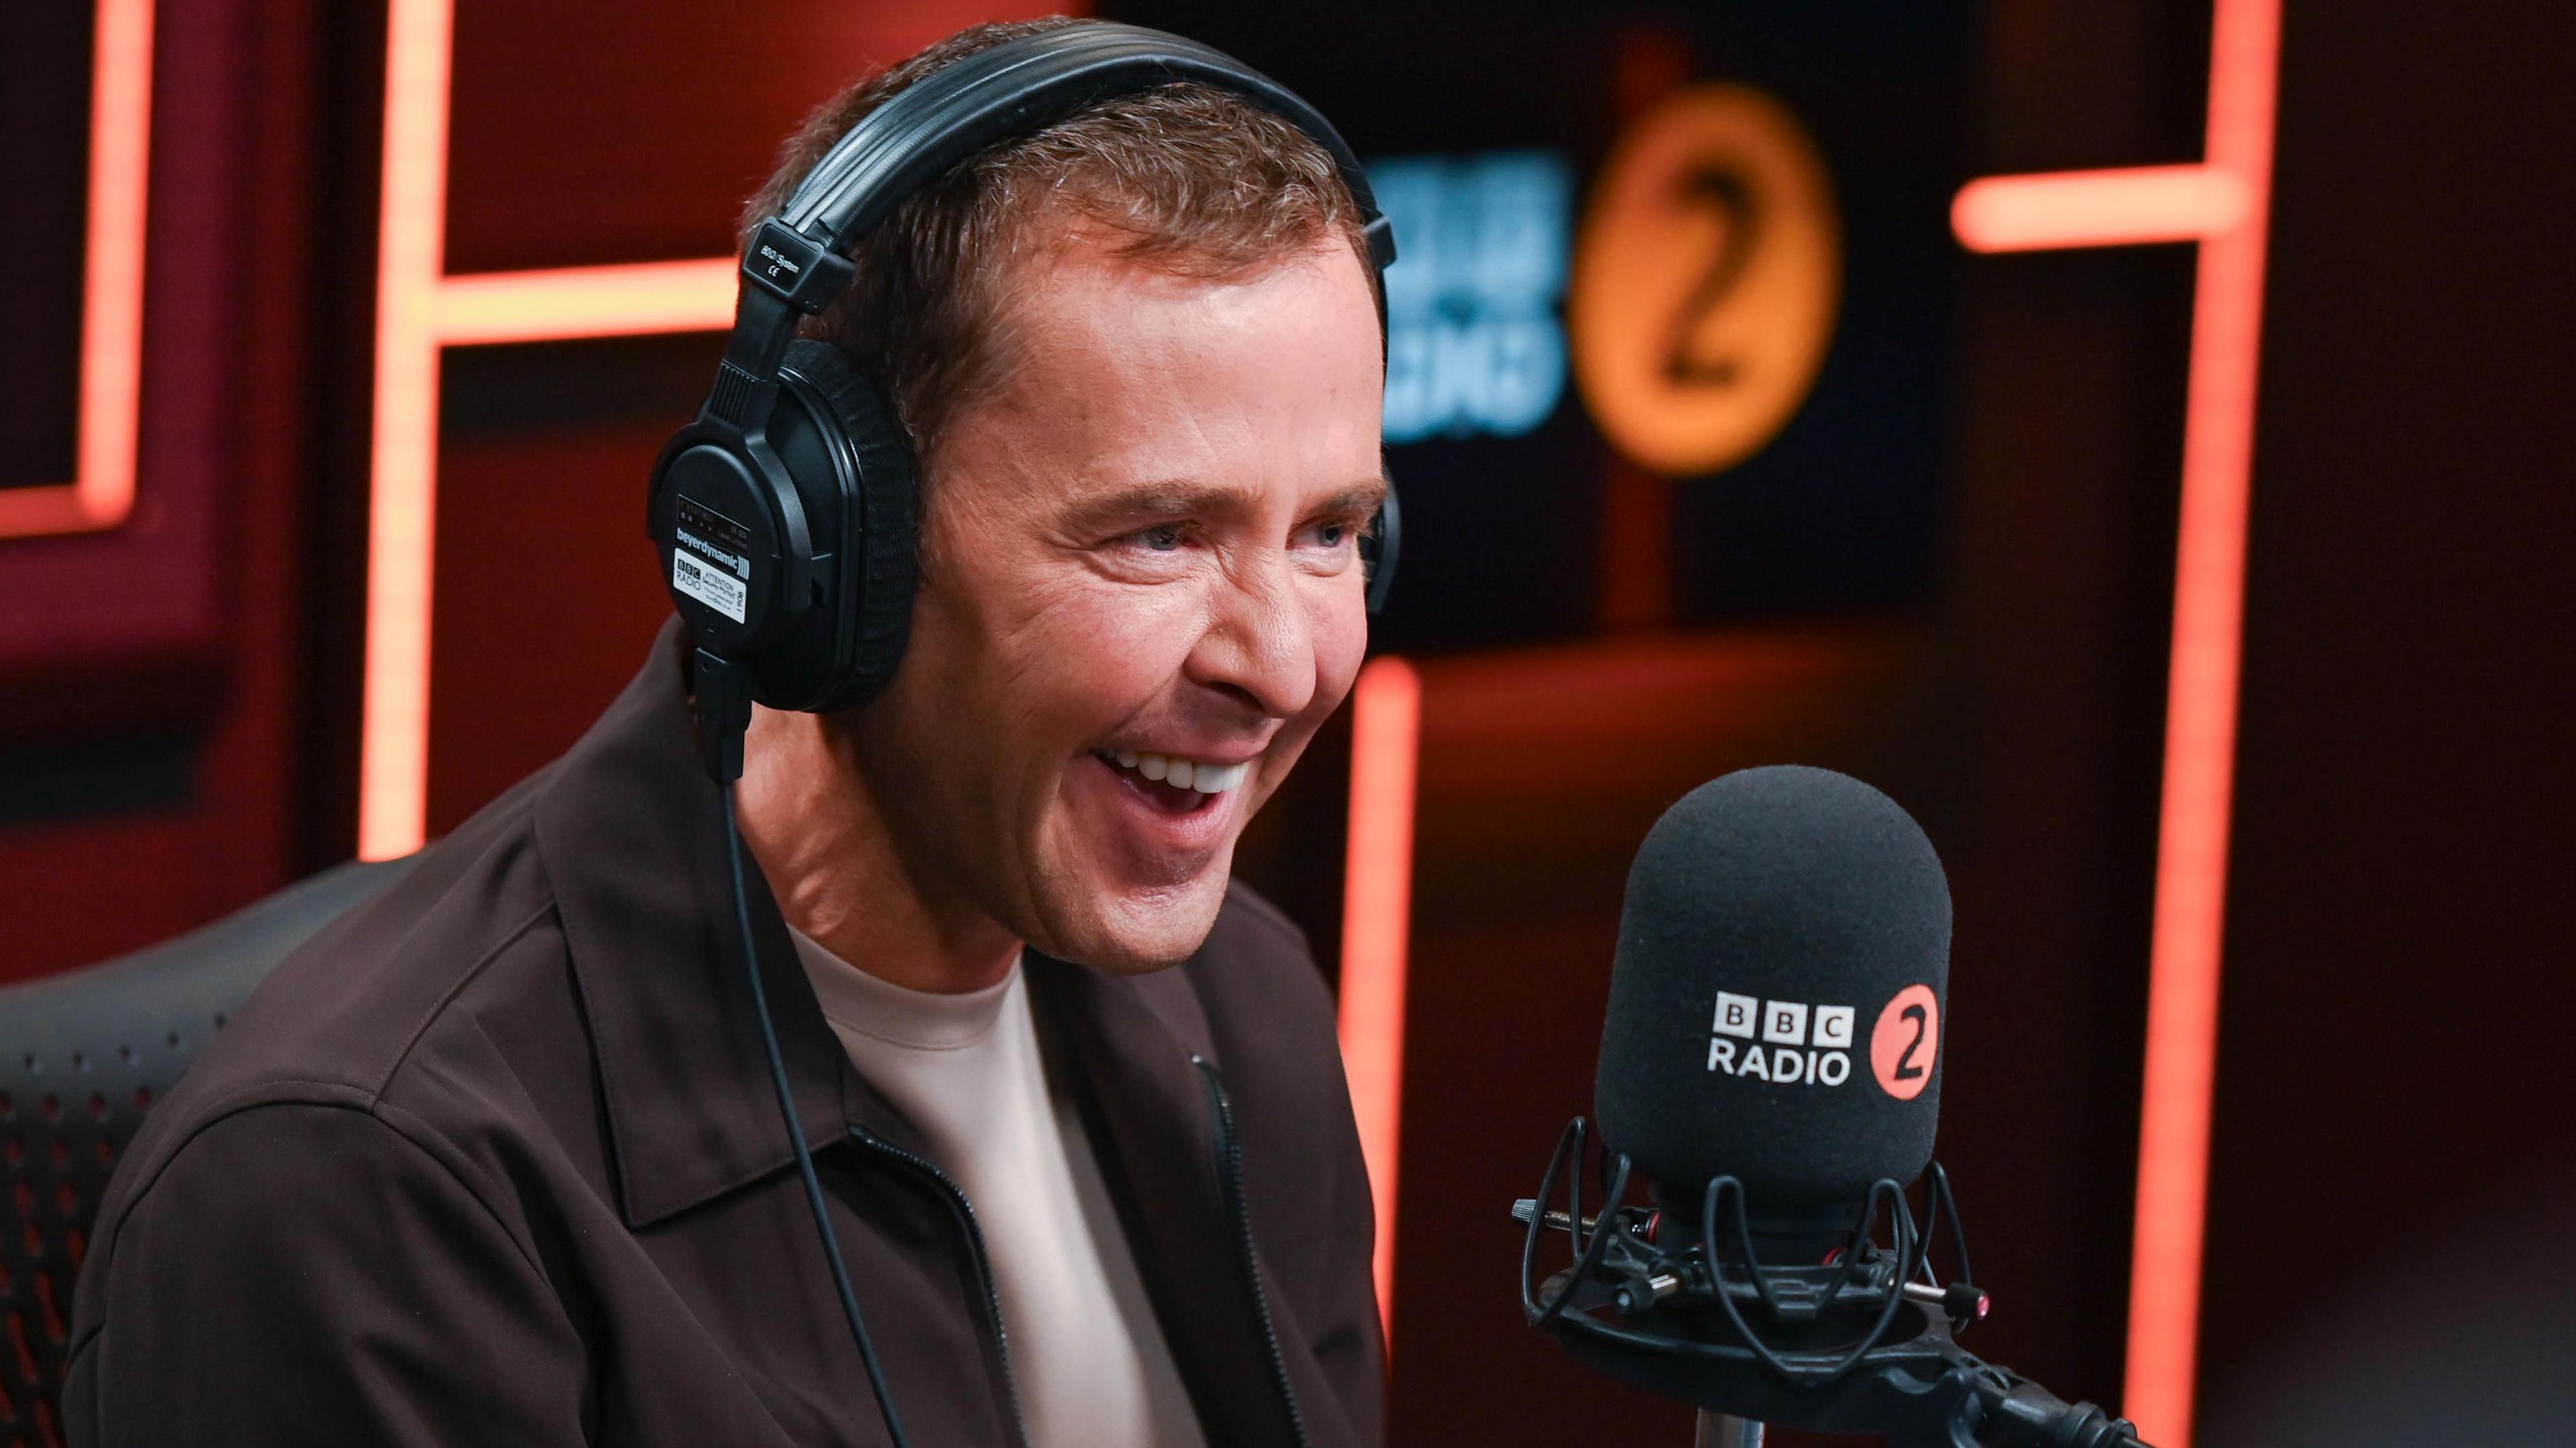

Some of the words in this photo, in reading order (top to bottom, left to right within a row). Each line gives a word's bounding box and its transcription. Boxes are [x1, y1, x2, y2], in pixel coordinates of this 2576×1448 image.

[1664, 156, 1761, 392] 2
[677, 526, 738, 570] beyerdynamic
[678, 559, 701, 580] BBC
[676, 571, 701, 591] RADIO
[705, 572, 734, 592] ATTENTION
[1719, 997, 1849, 1043] BBC
[1894, 1003, 1927, 1081] 2
[1707, 1038, 1851, 1087] RADIO
